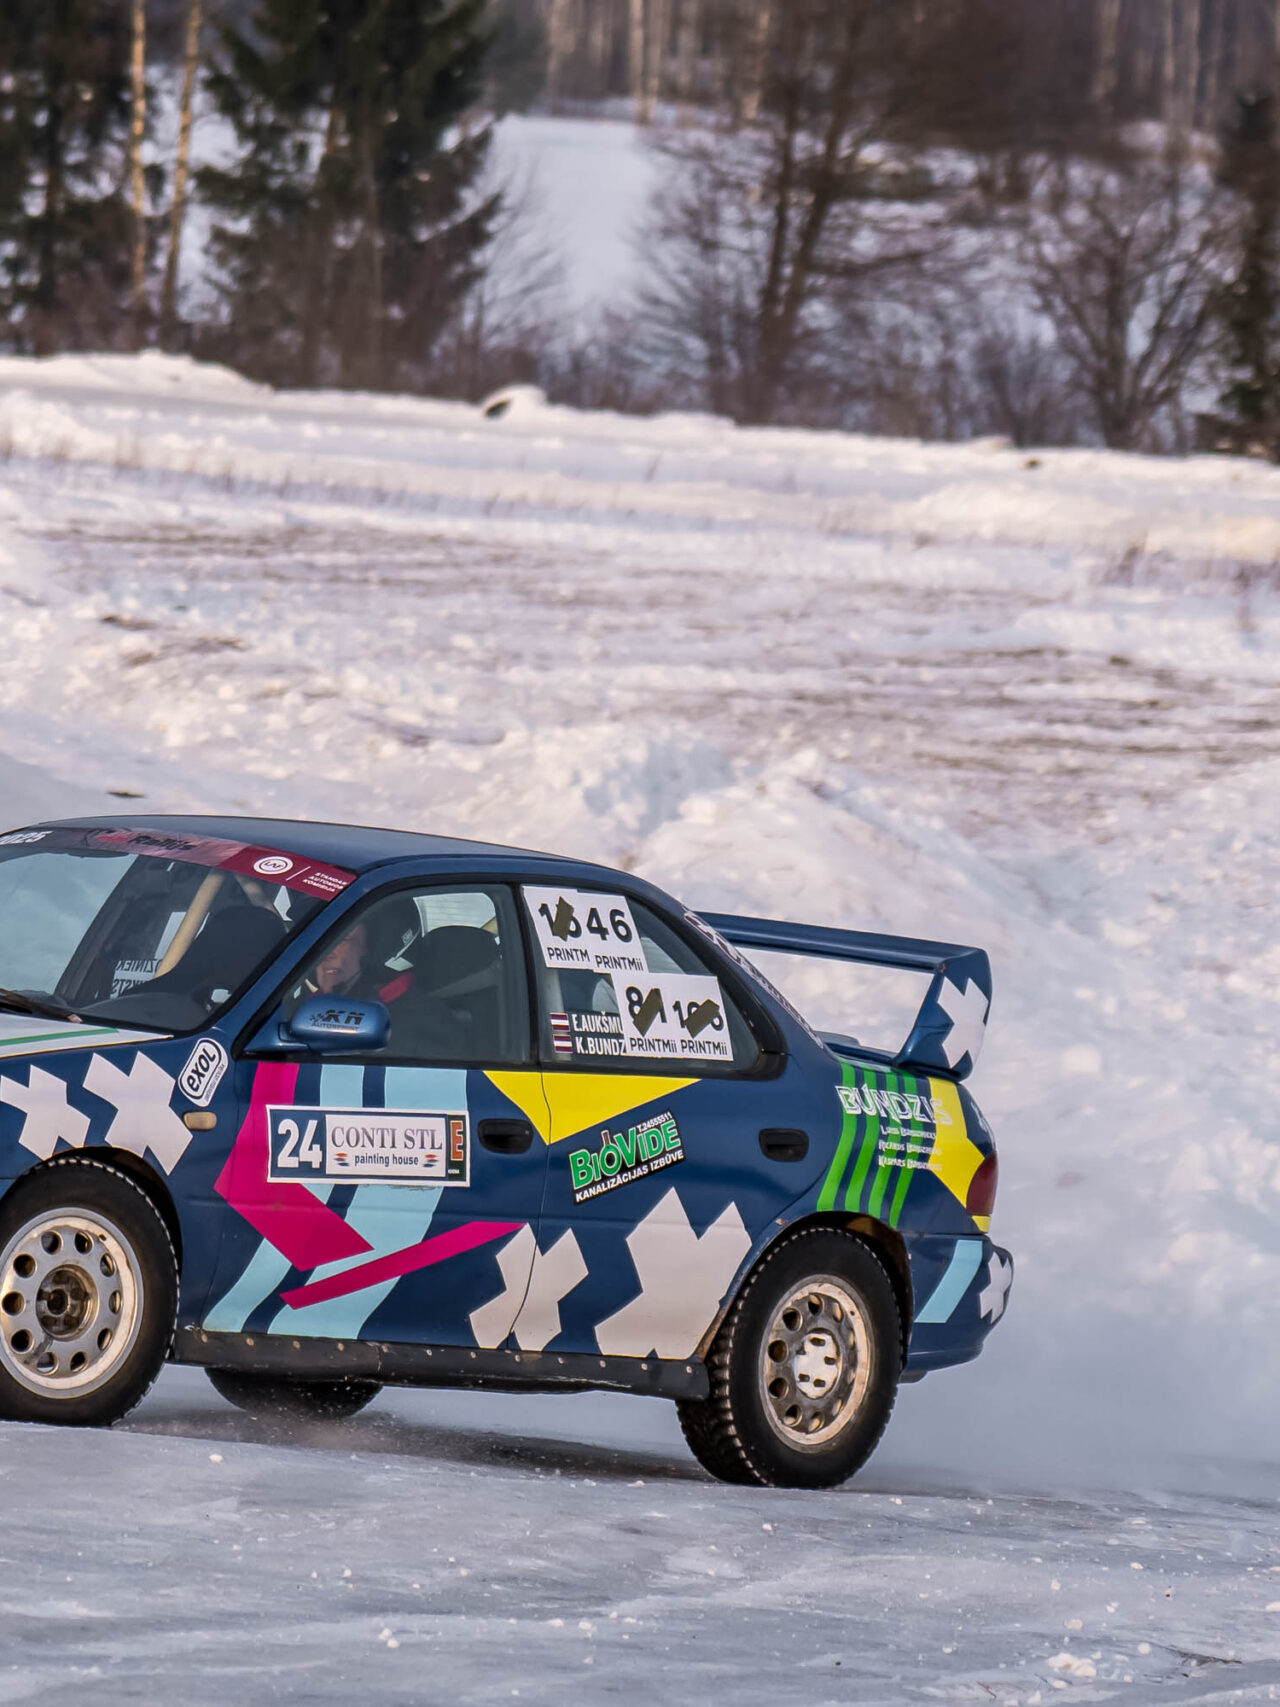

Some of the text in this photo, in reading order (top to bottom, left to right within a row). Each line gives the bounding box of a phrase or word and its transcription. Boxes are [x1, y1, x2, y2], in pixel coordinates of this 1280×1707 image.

[586, 907, 633, 943] 46
[276, 1118, 464, 1169] 24 CONTI STL E
[354, 1153, 419, 1168] painting house
[574, 1149, 685, 1203] KANALIZĀCIJAS IZBŪVE
